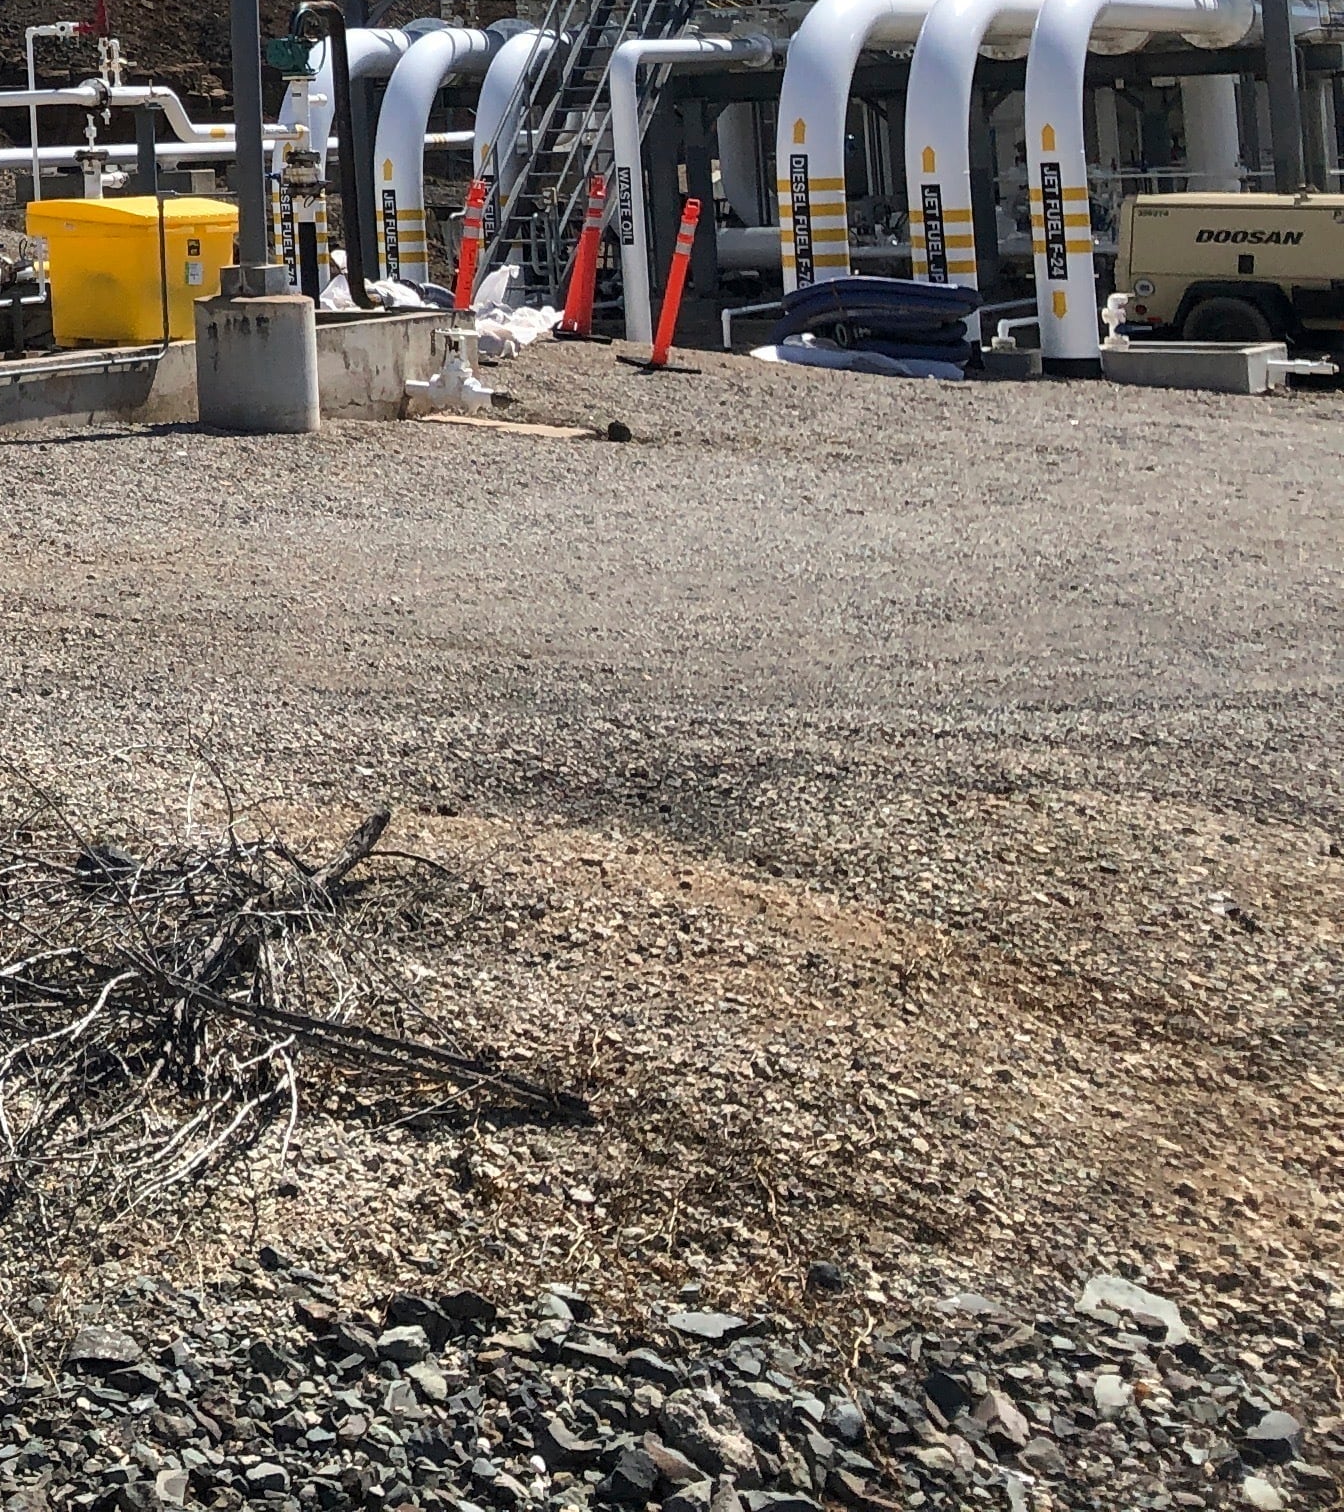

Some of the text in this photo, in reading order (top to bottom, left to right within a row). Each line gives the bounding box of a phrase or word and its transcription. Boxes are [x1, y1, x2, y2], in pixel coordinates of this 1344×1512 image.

[792, 157, 806, 211] DIESEL
[384, 192, 395, 216] JET
[619, 169, 634, 245] WASTE OIL
[924, 188, 939, 217] JET
[282, 222, 293, 254] FUEL
[386, 219, 397, 251] FUEL
[795, 215, 810, 254] FUEL
[1044, 166, 1065, 277] JET FUEL F-24
[1196, 229, 1303, 245] DOOSAN
[927, 221, 943, 261] FUEL
